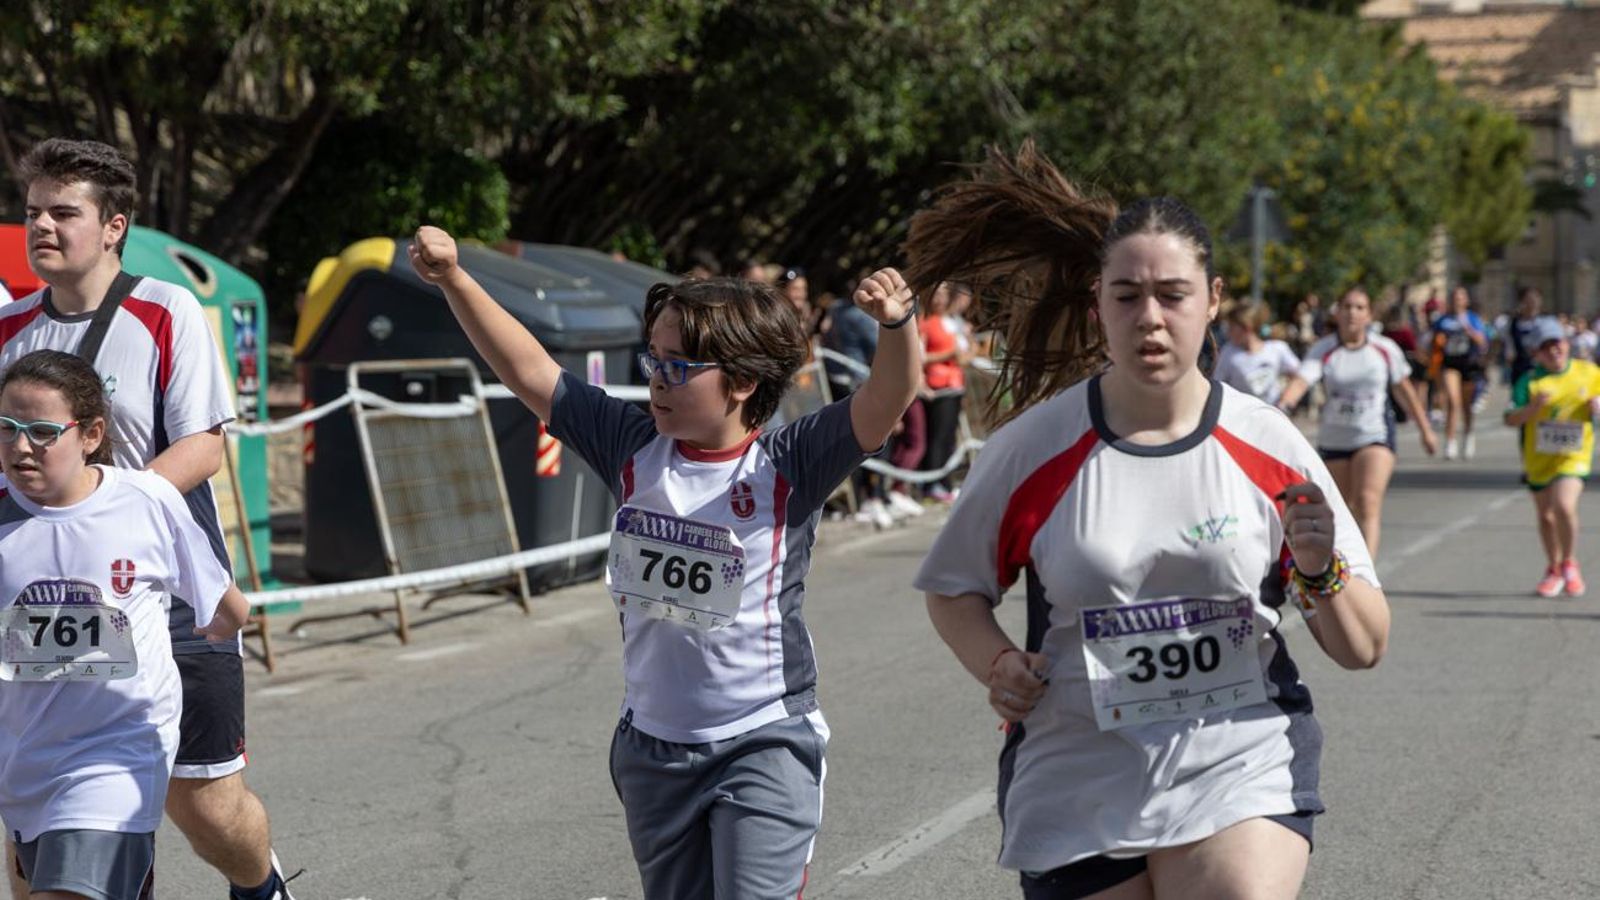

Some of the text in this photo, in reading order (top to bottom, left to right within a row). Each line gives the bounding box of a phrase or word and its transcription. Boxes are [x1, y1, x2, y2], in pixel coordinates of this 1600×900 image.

[639, 513, 684, 541] XXXVI
[639, 548, 713, 595] 766
[28, 615, 100, 647] 761
[1115, 606, 1171, 632] XXXVI
[1125, 635, 1221, 683] 390
